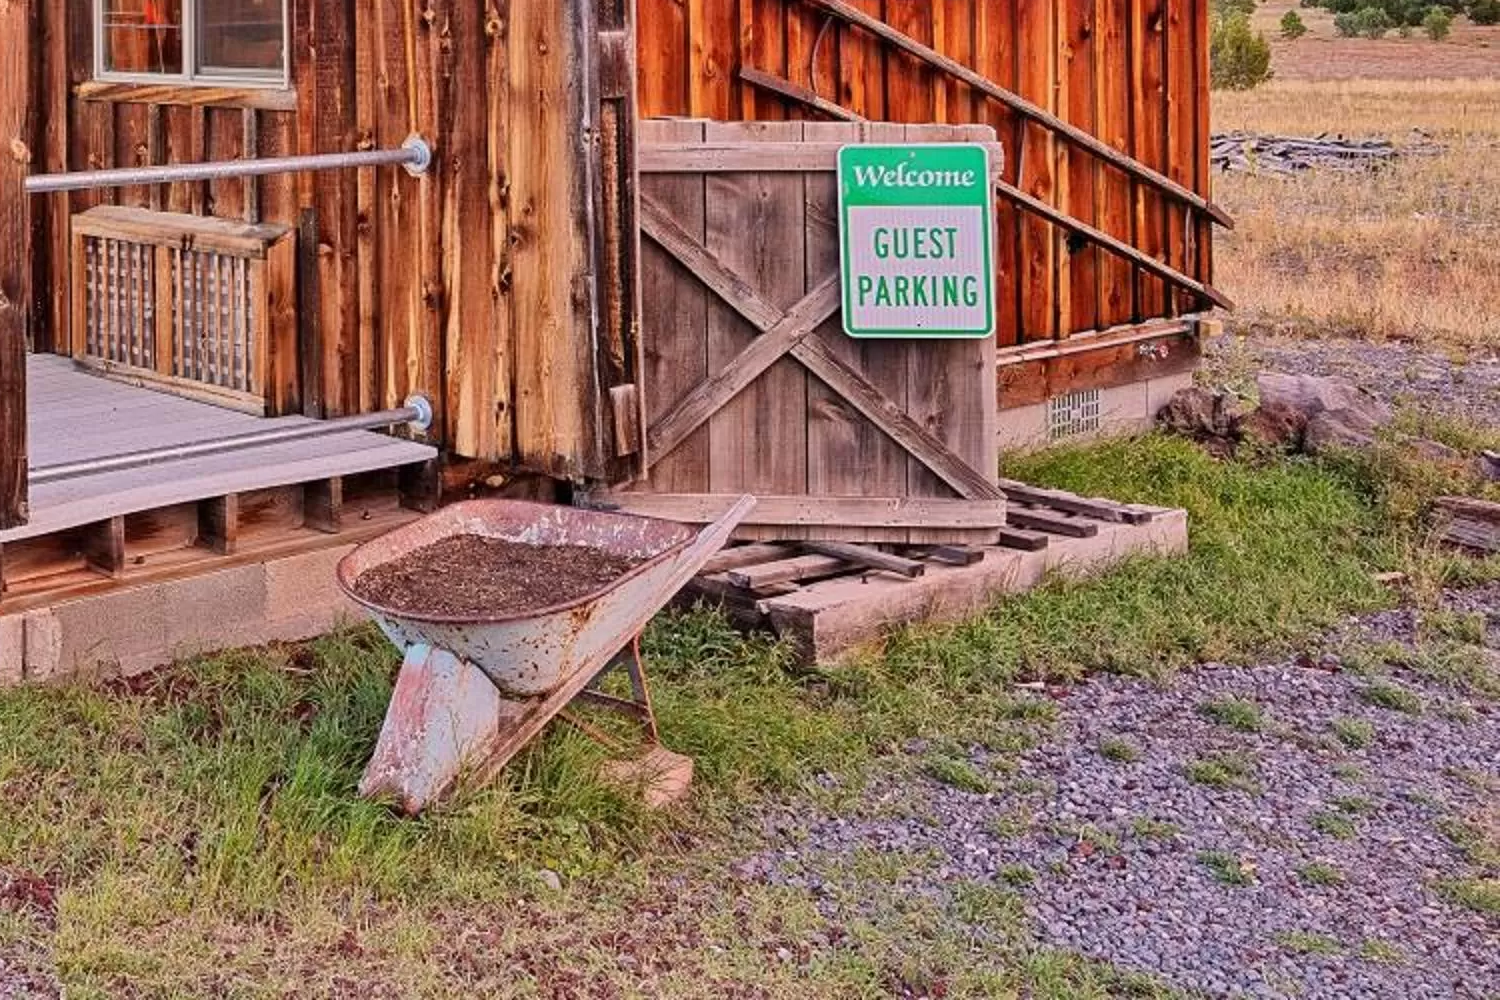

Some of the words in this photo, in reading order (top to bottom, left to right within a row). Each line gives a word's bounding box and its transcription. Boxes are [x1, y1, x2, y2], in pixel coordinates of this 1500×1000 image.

[852, 162, 976, 187] Welcome
[874, 228, 958, 259] GUEST
[858, 275, 978, 307] PARKING
